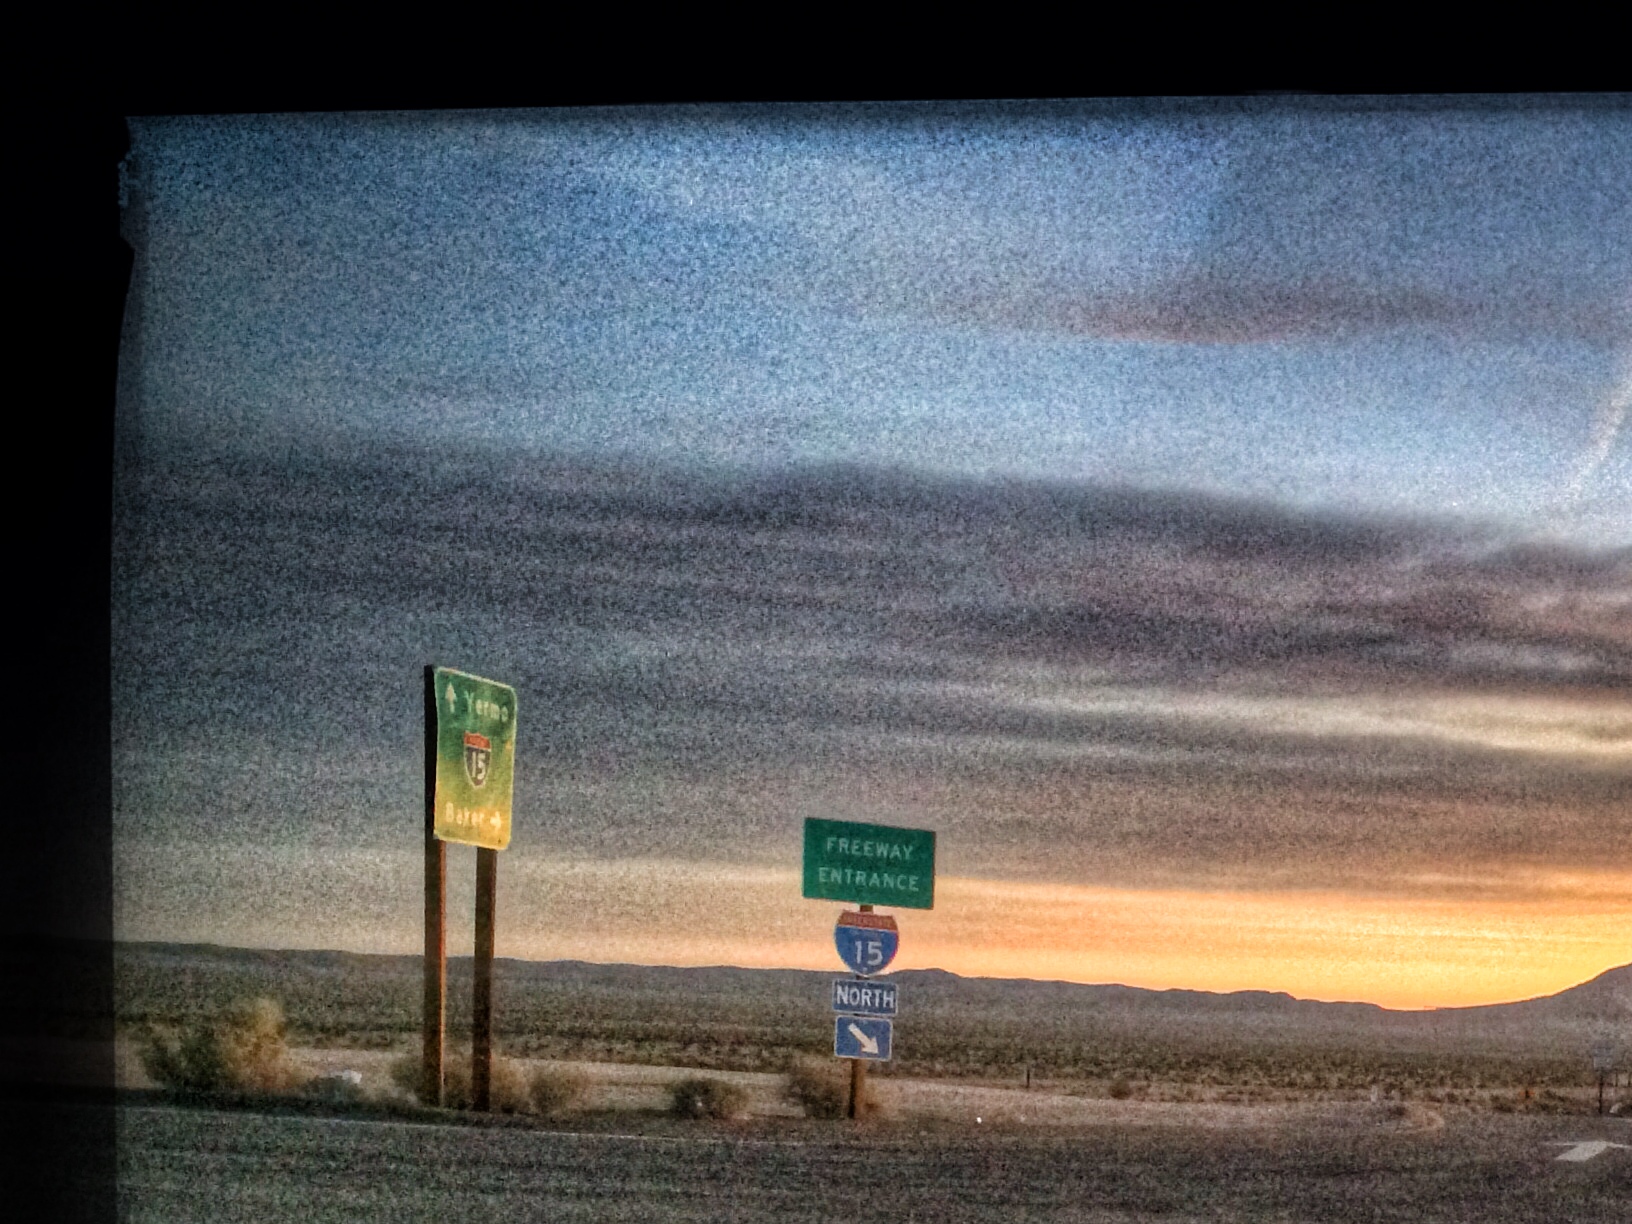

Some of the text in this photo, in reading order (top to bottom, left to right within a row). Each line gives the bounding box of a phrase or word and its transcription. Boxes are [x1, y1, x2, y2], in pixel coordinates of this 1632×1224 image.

[471, 752, 486, 780] 15
[827, 837, 913, 860] FREEWAY
[818, 867, 919, 892] ENTRANCE
[854, 940, 883, 966] 15
[836, 984, 894, 1008] NORTH
